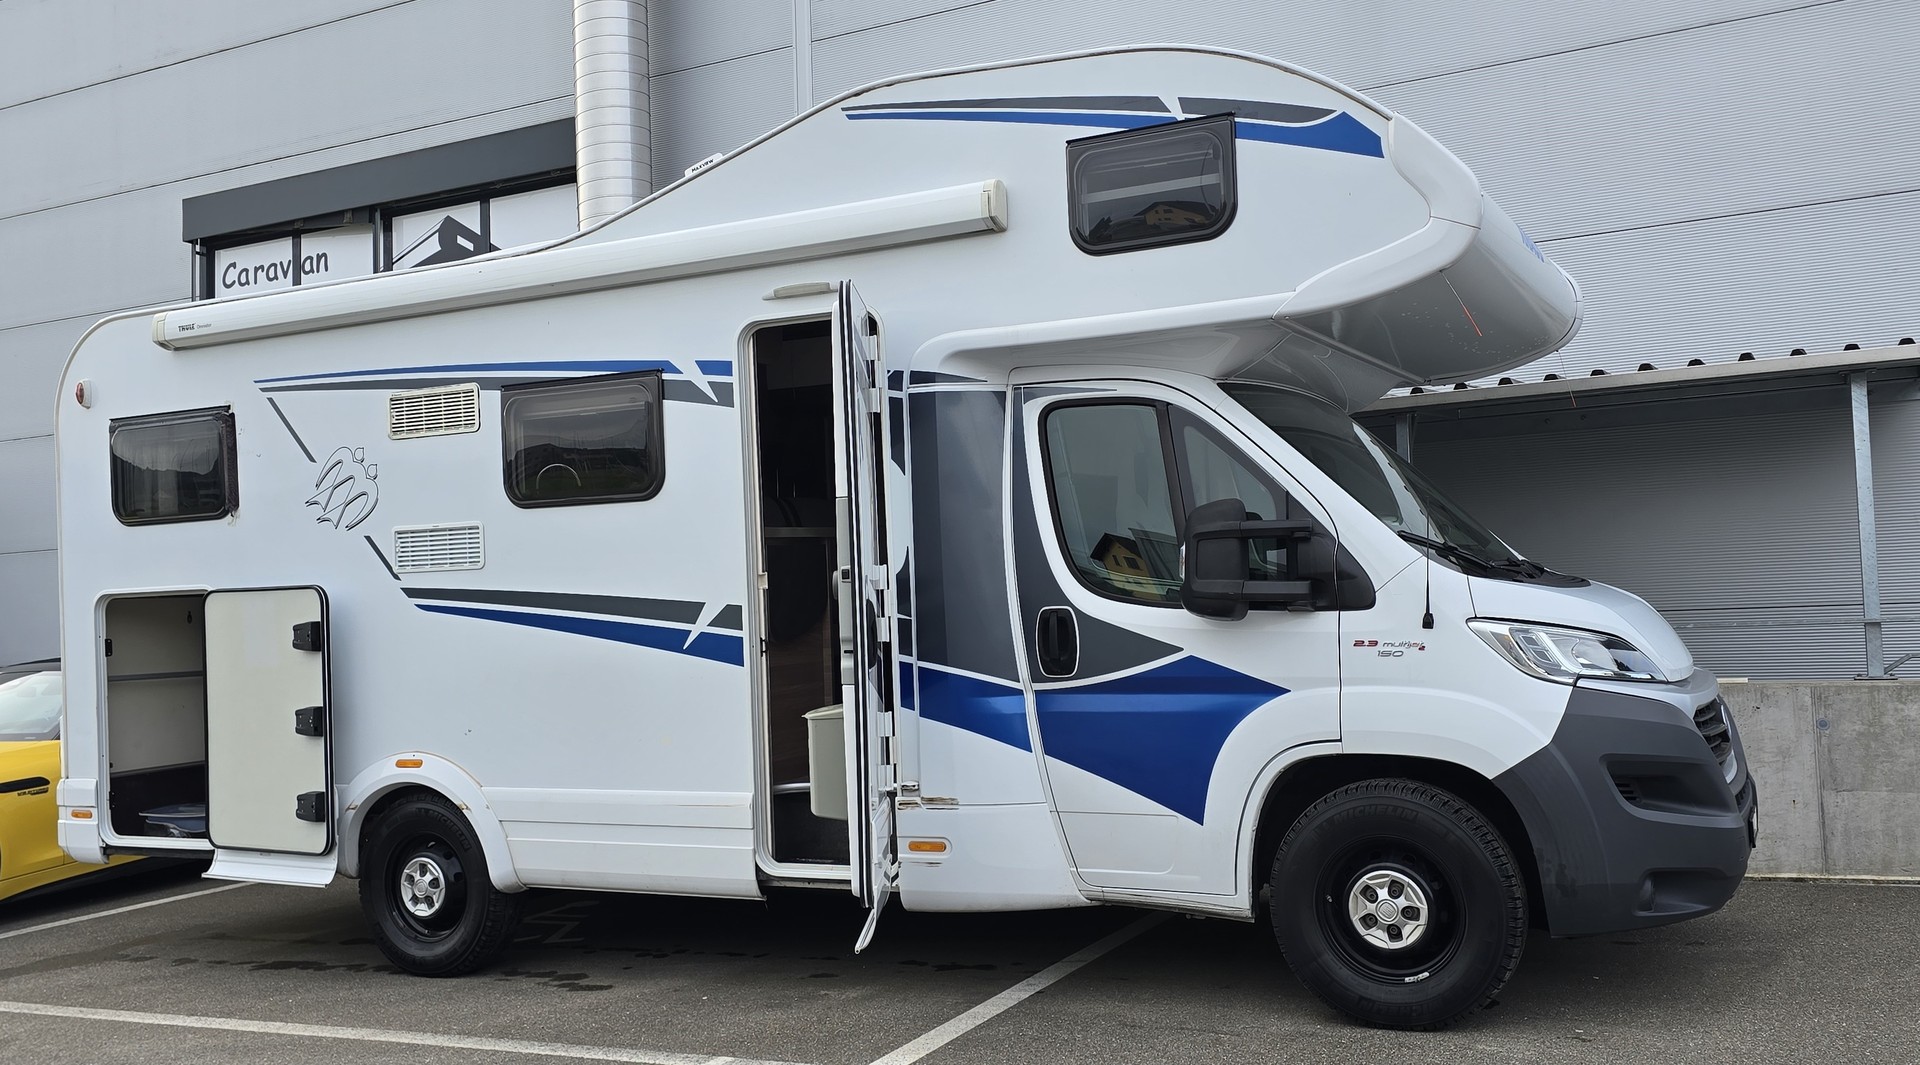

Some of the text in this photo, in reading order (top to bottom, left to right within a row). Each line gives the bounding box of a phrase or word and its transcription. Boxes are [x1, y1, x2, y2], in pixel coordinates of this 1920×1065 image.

[222, 252, 328, 289] Caravan
[178, 323, 196, 332] THULE
[1353, 640, 1378, 648] 2.3
[1377, 650, 1404, 658] 150
[1334, 804, 1420, 824] MICHELIN
[428, 809, 473, 852] MICHELIN
